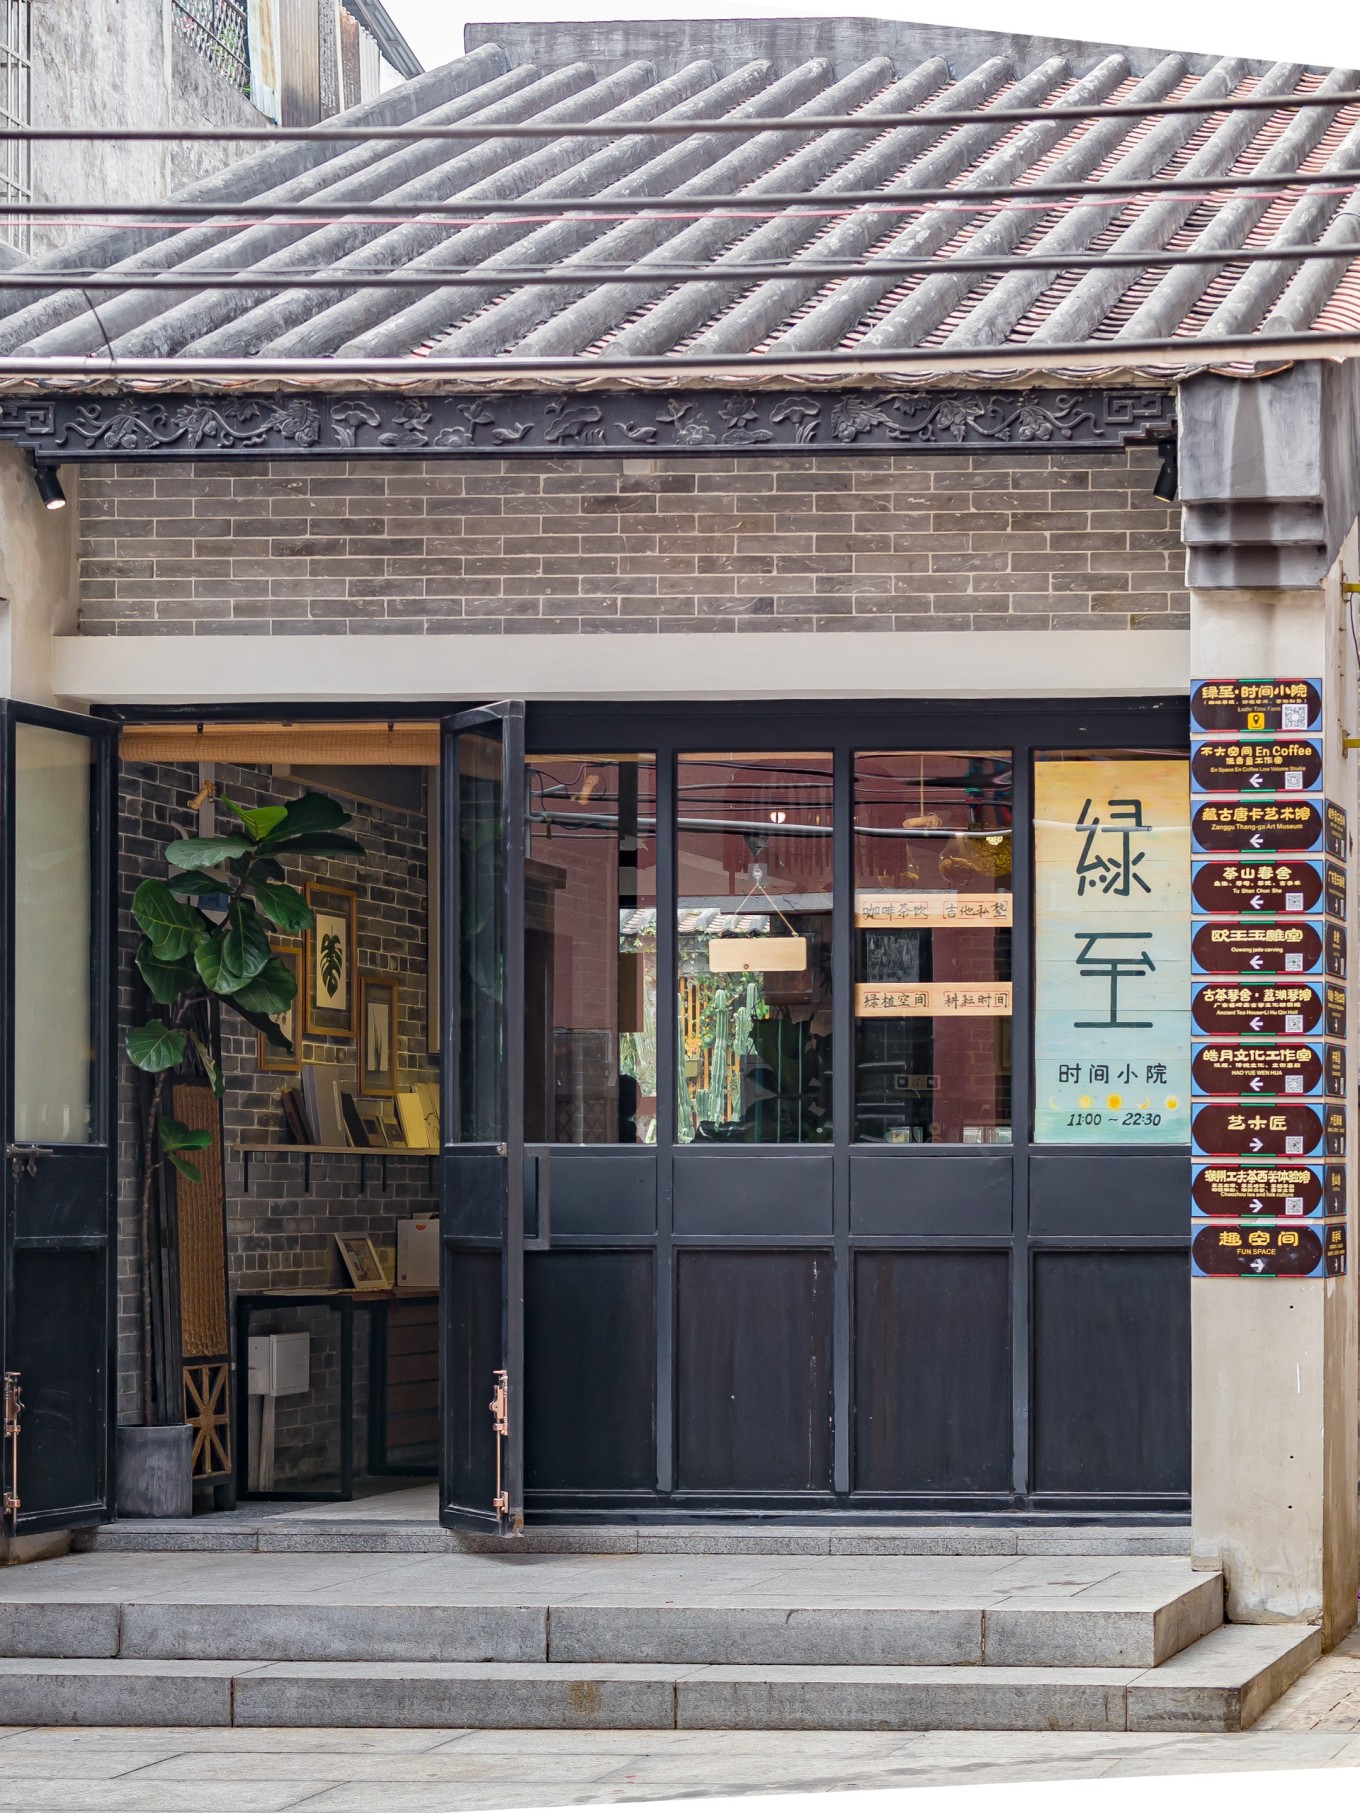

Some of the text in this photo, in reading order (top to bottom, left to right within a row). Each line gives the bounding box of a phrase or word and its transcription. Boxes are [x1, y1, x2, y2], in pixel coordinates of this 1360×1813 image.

[1201, 683, 1308, 699] 绿至·时间小院
[1255, 746, 1270, 756] En
[1272, 744, 1312, 756] Coffee
[1202, 806, 1311, 821] 藏古唐卡艺术馆
[864, 992, 927, 1009] 绿植空间
[1202, 1048, 1312, 1062] 皓月文化工作室
[1059, 1063, 1167, 1084] 时间小院
[1067, 1113, 1102, 1126] 11:00
[1122, 1112, 1161, 1126] 22:30
[1218, 1230, 1299, 1247] 趣空间
